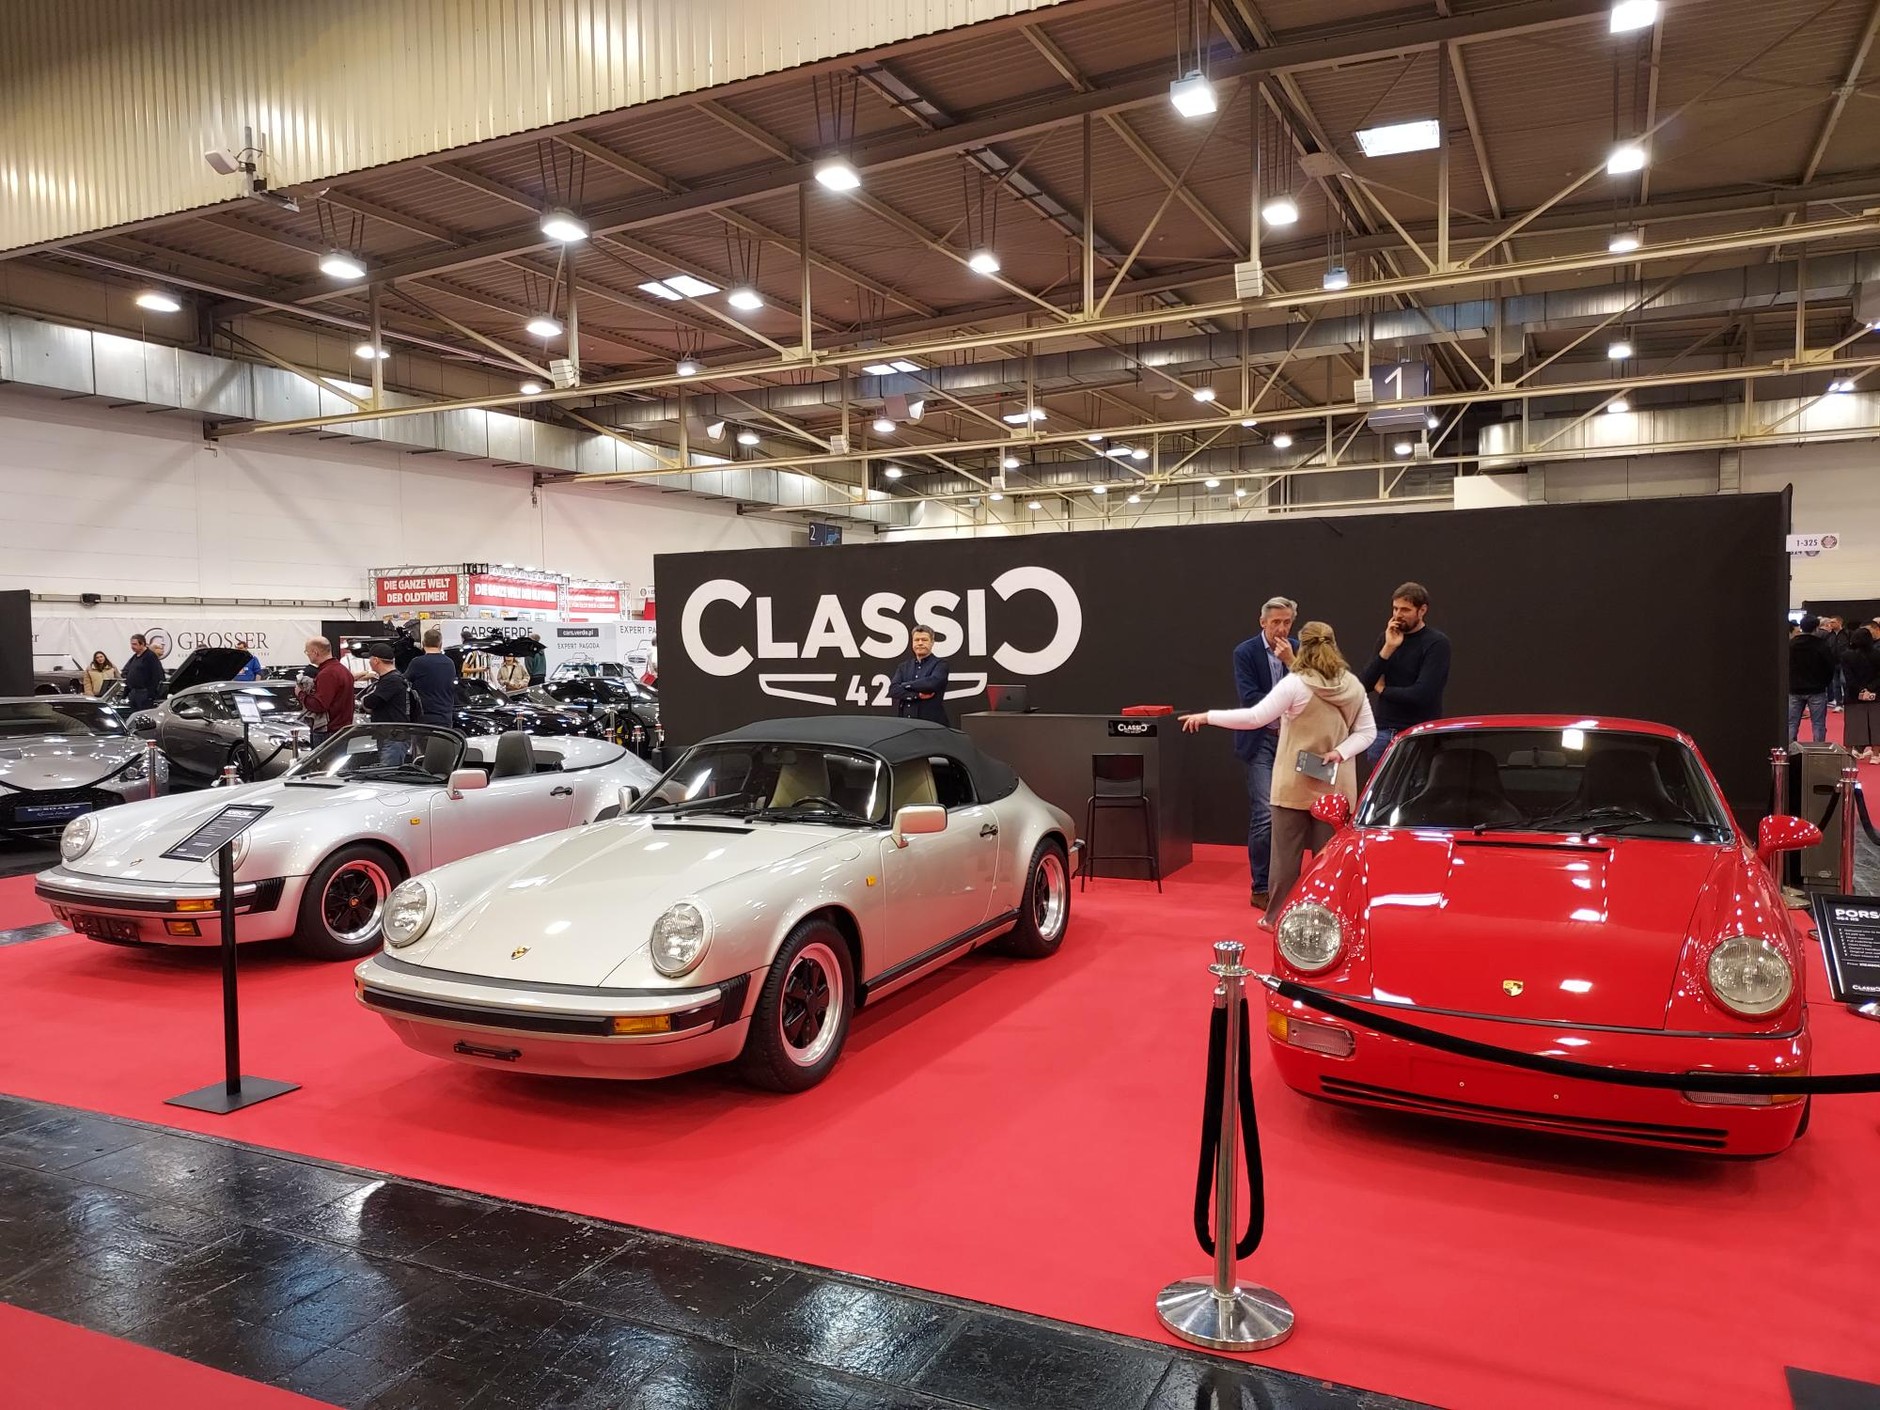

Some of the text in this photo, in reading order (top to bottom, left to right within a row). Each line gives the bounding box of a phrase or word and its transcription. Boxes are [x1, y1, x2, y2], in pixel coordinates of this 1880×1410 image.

[1384, 367, 1402, 410] 1
[810, 525, 816, 541] 2
[1796, 539, 1818, 547] 1-325
[383, 578, 451, 591] DIE GANZE WELT
[386, 591, 448, 603] DER OLDTIMER!
[681, 566, 1083, 677] CLASSIC
[620, 625, 646, 634] EXPERT
[178, 631, 269, 651] GROSSER
[1835, 908, 1880, 919] PORS
